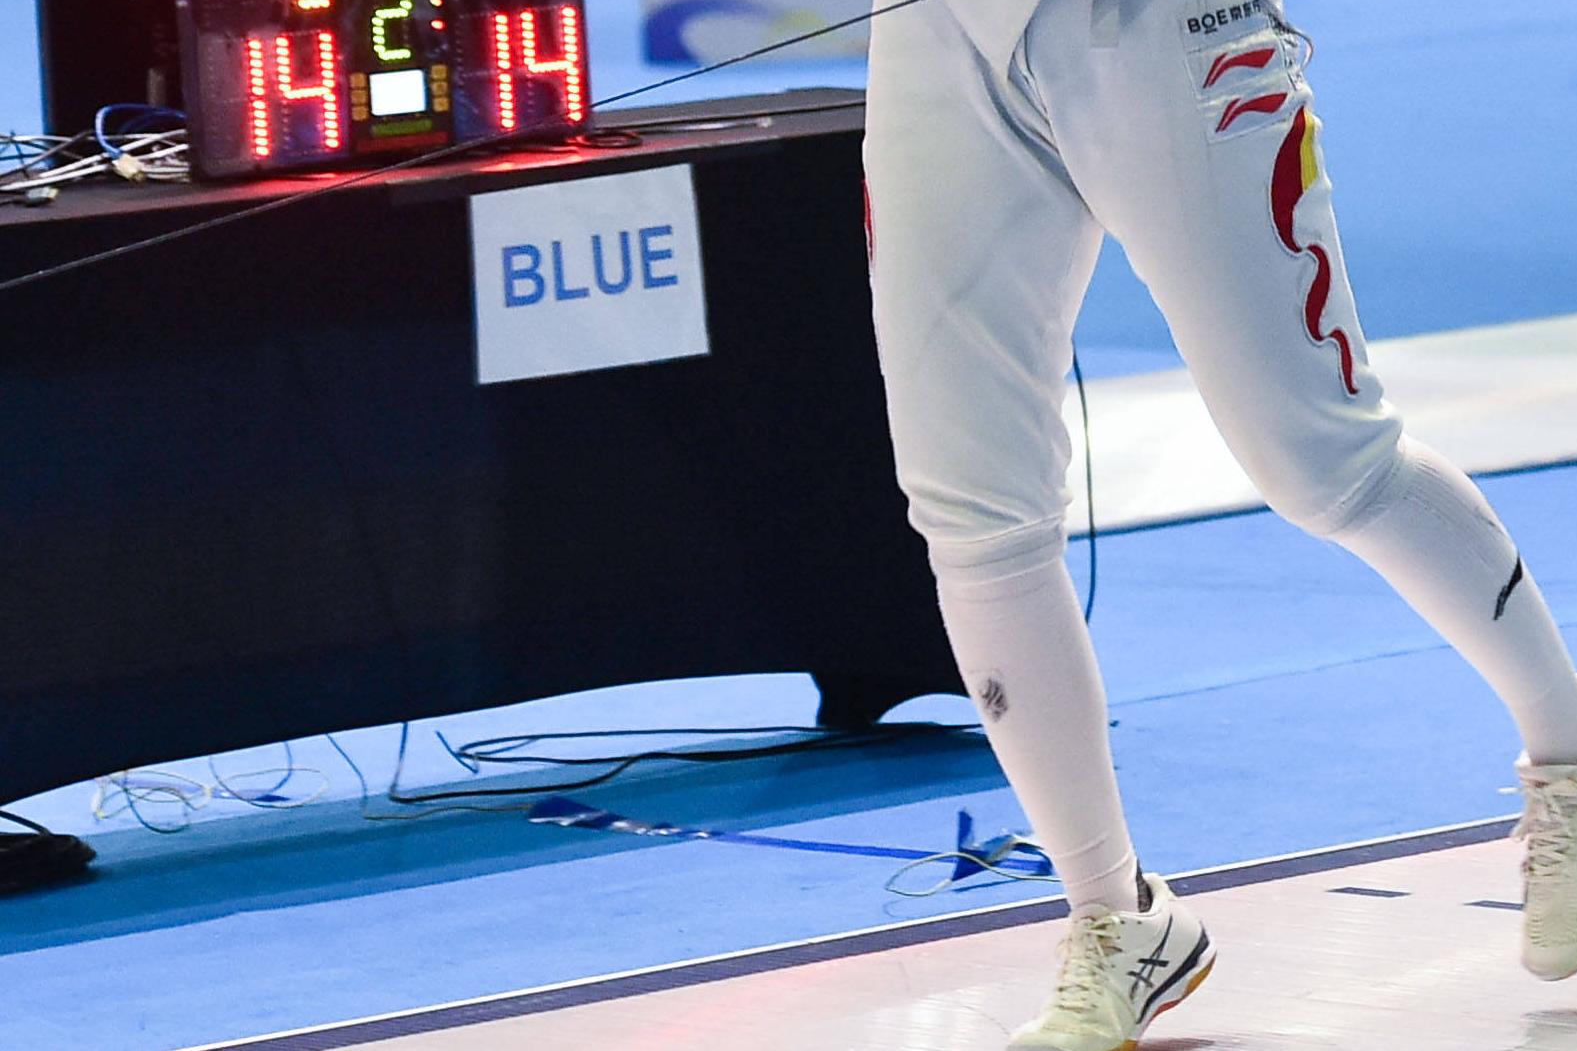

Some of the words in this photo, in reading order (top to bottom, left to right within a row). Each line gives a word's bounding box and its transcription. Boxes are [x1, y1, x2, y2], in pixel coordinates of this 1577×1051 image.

[247, 32, 341, 160] 14
[494, 5, 583, 131] 14
[502, 225, 680, 309] BLUE
